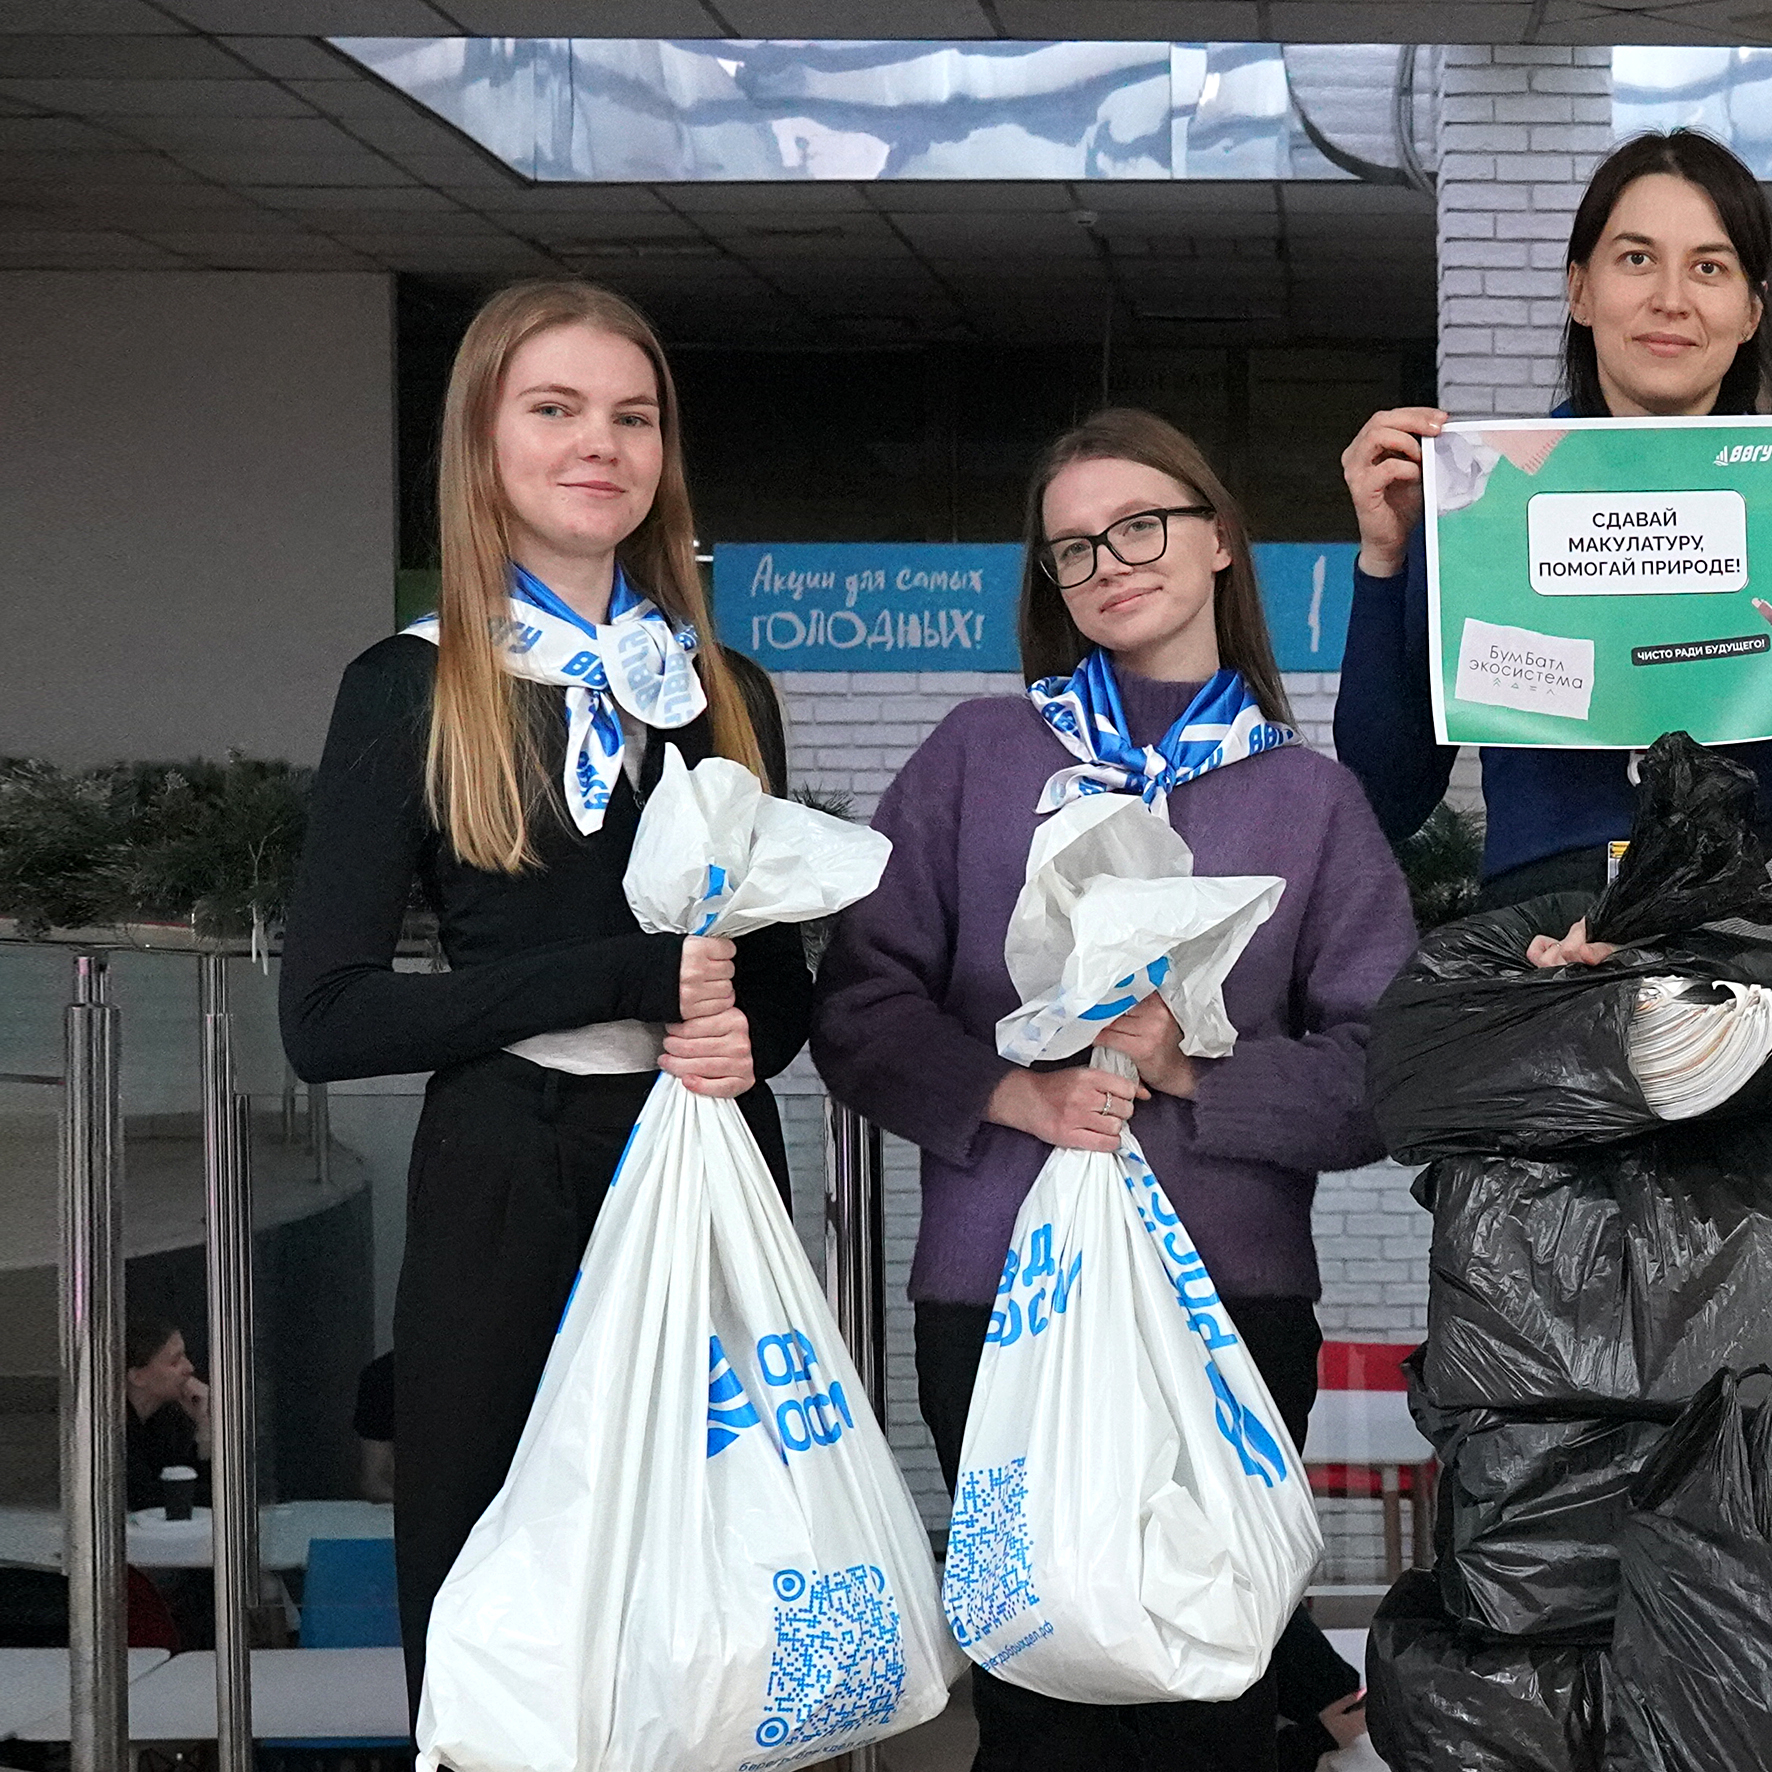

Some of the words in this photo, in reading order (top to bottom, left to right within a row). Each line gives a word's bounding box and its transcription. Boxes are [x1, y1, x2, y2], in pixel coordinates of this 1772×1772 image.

[1592, 508, 1677, 529] СДАВАЙ
[1568, 535, 1704, 552] МАКУЛАТУРУ,
[1539, 557, 1635, 577] ПОМОГАЙ
[1641, 558, 1740, 576] ПРИРОДЕ!
[751, 553, 836, 601] Акции
[845, 569, 887, 608] для
[752, 608, 985, 651] ГОЛОДНЫХ!
[1489, 645, 1565, 672] БумБатл
[1637, 649, 1673, 661] ЧИСТО
[1675, 645, 1703, 658] РАДИ
[1705, 639, 1765, 655] БУДУЩЕГО!
[1469, 659, 1583, 689] экосистема
